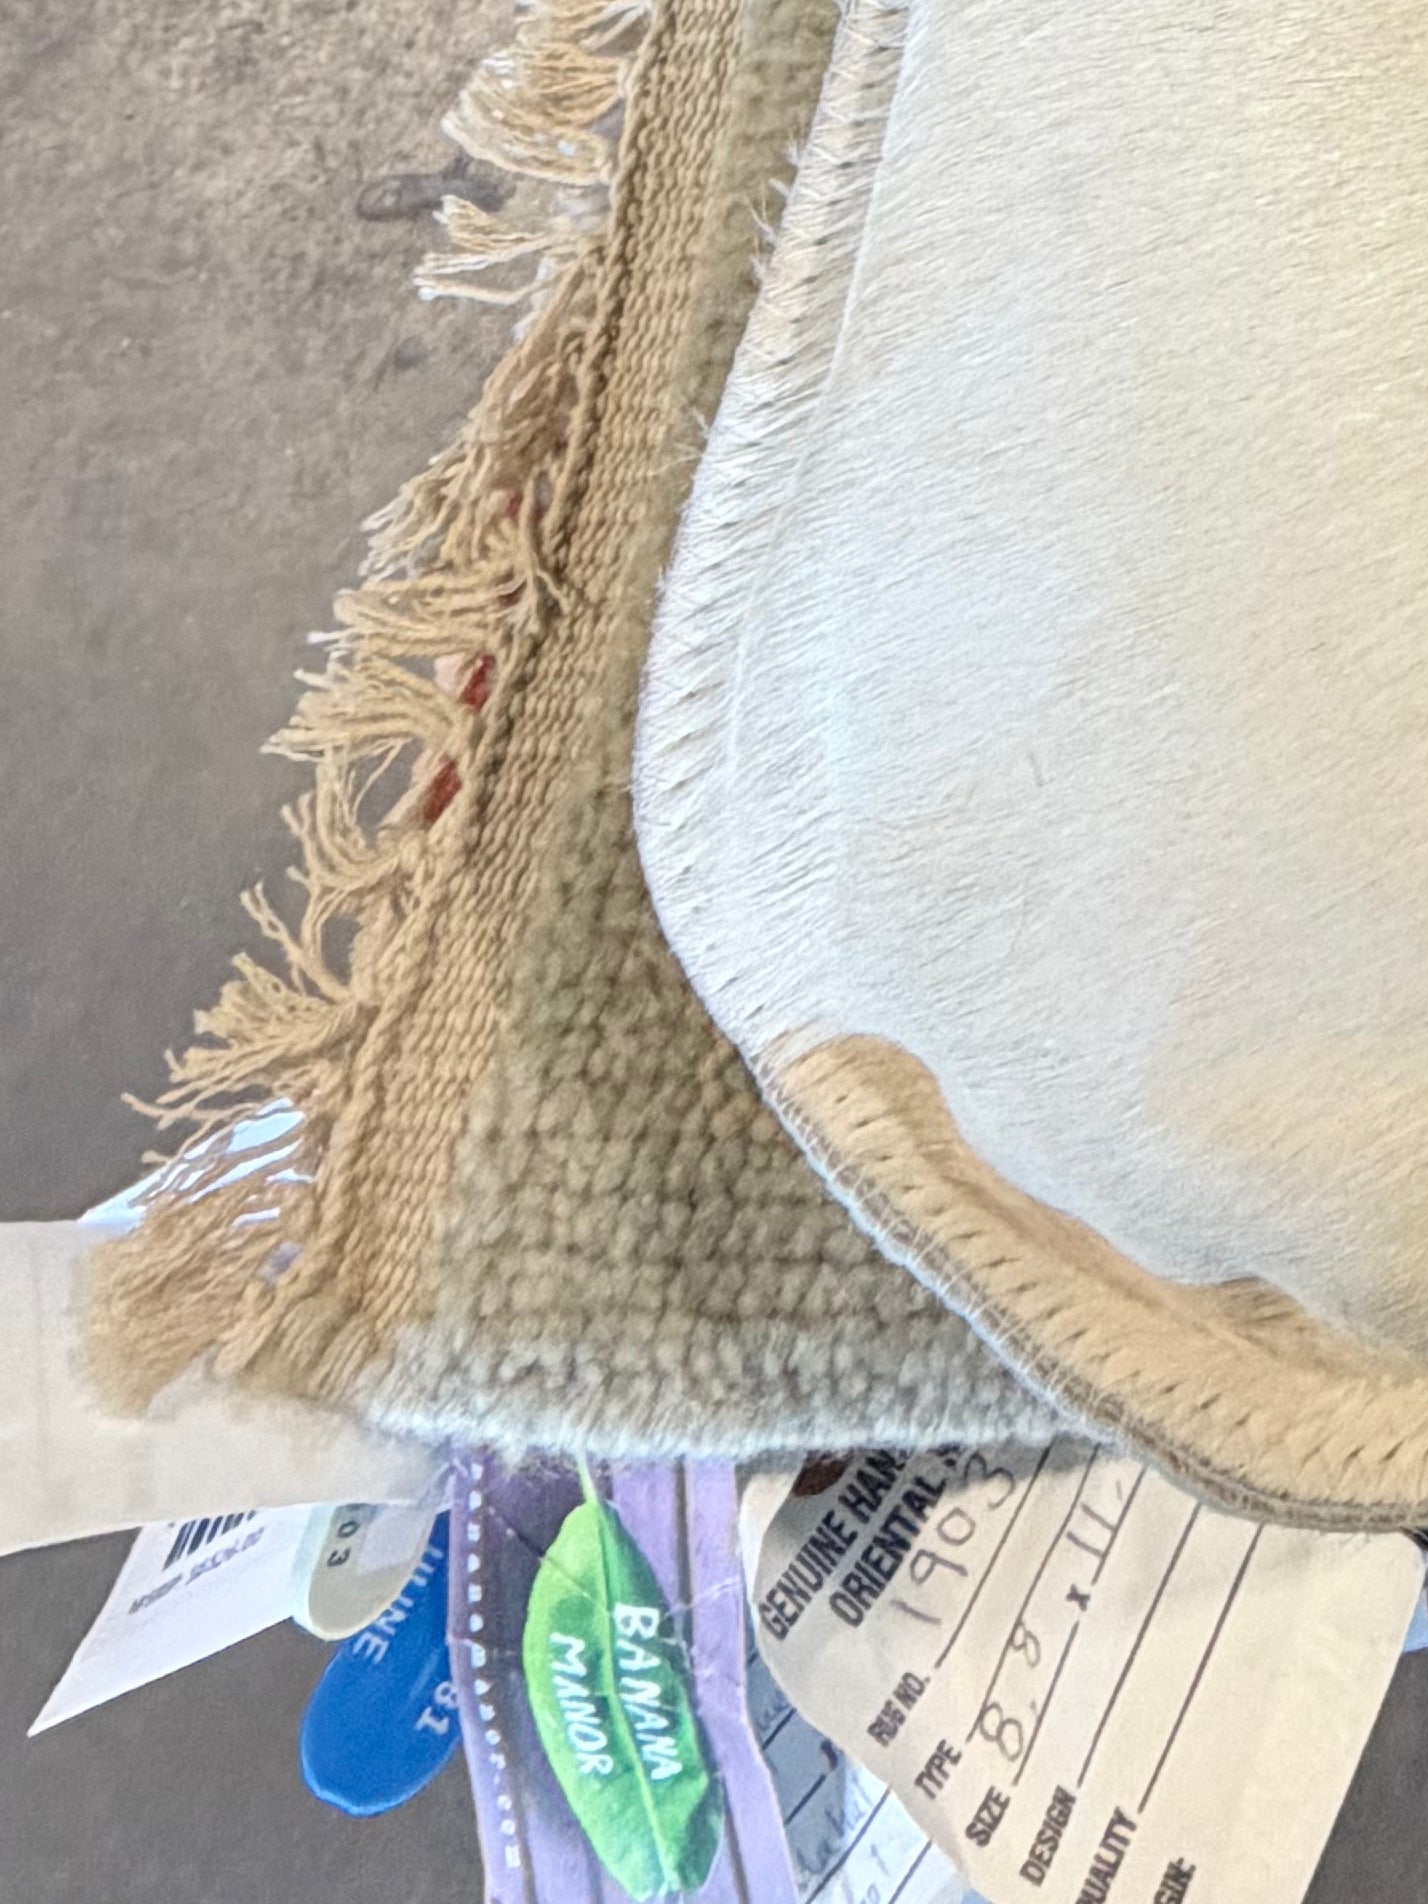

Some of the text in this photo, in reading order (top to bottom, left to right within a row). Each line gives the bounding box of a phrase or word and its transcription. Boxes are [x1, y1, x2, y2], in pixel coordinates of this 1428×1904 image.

[326, 1503, 368, 1569] 03
[757, 1509, 858, 1641] GENUINE
[837, 1448, 907, 1524] HAN
[828, 1474, 947, 1628] ORIENTAL
[889, 1448, 1016, 1626] 1903
[549, 1630, 615, 1776] MANOR
[612, 1602, 684, 1780] BANANA
[892, 1672, 931, 1711] NO.
[912, 1738, 963, 1800] TYPE
[963, 1784, 1012, 1848] SIZE
[1018, 1784, 1077, 1887] DESIGN
[1074, 1805, 1138, 1904] UALITY
